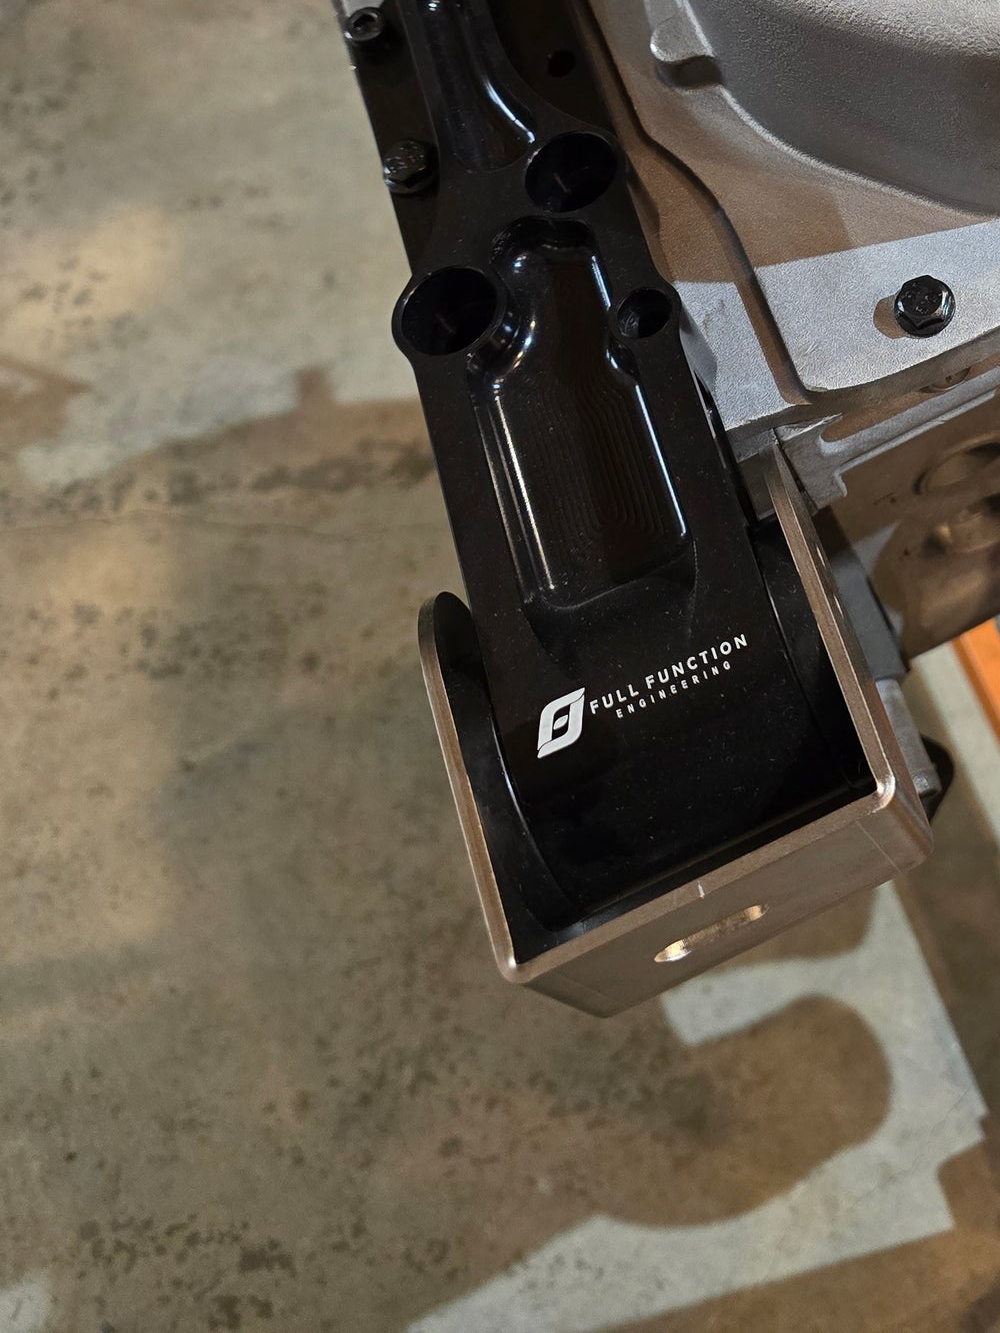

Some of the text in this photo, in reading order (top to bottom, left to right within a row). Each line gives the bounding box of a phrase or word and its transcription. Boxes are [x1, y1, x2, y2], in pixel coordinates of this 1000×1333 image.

[589, 633, 749, 715] FULL FUNCTION
[616, 660, 732, 719] ENGINEERING
